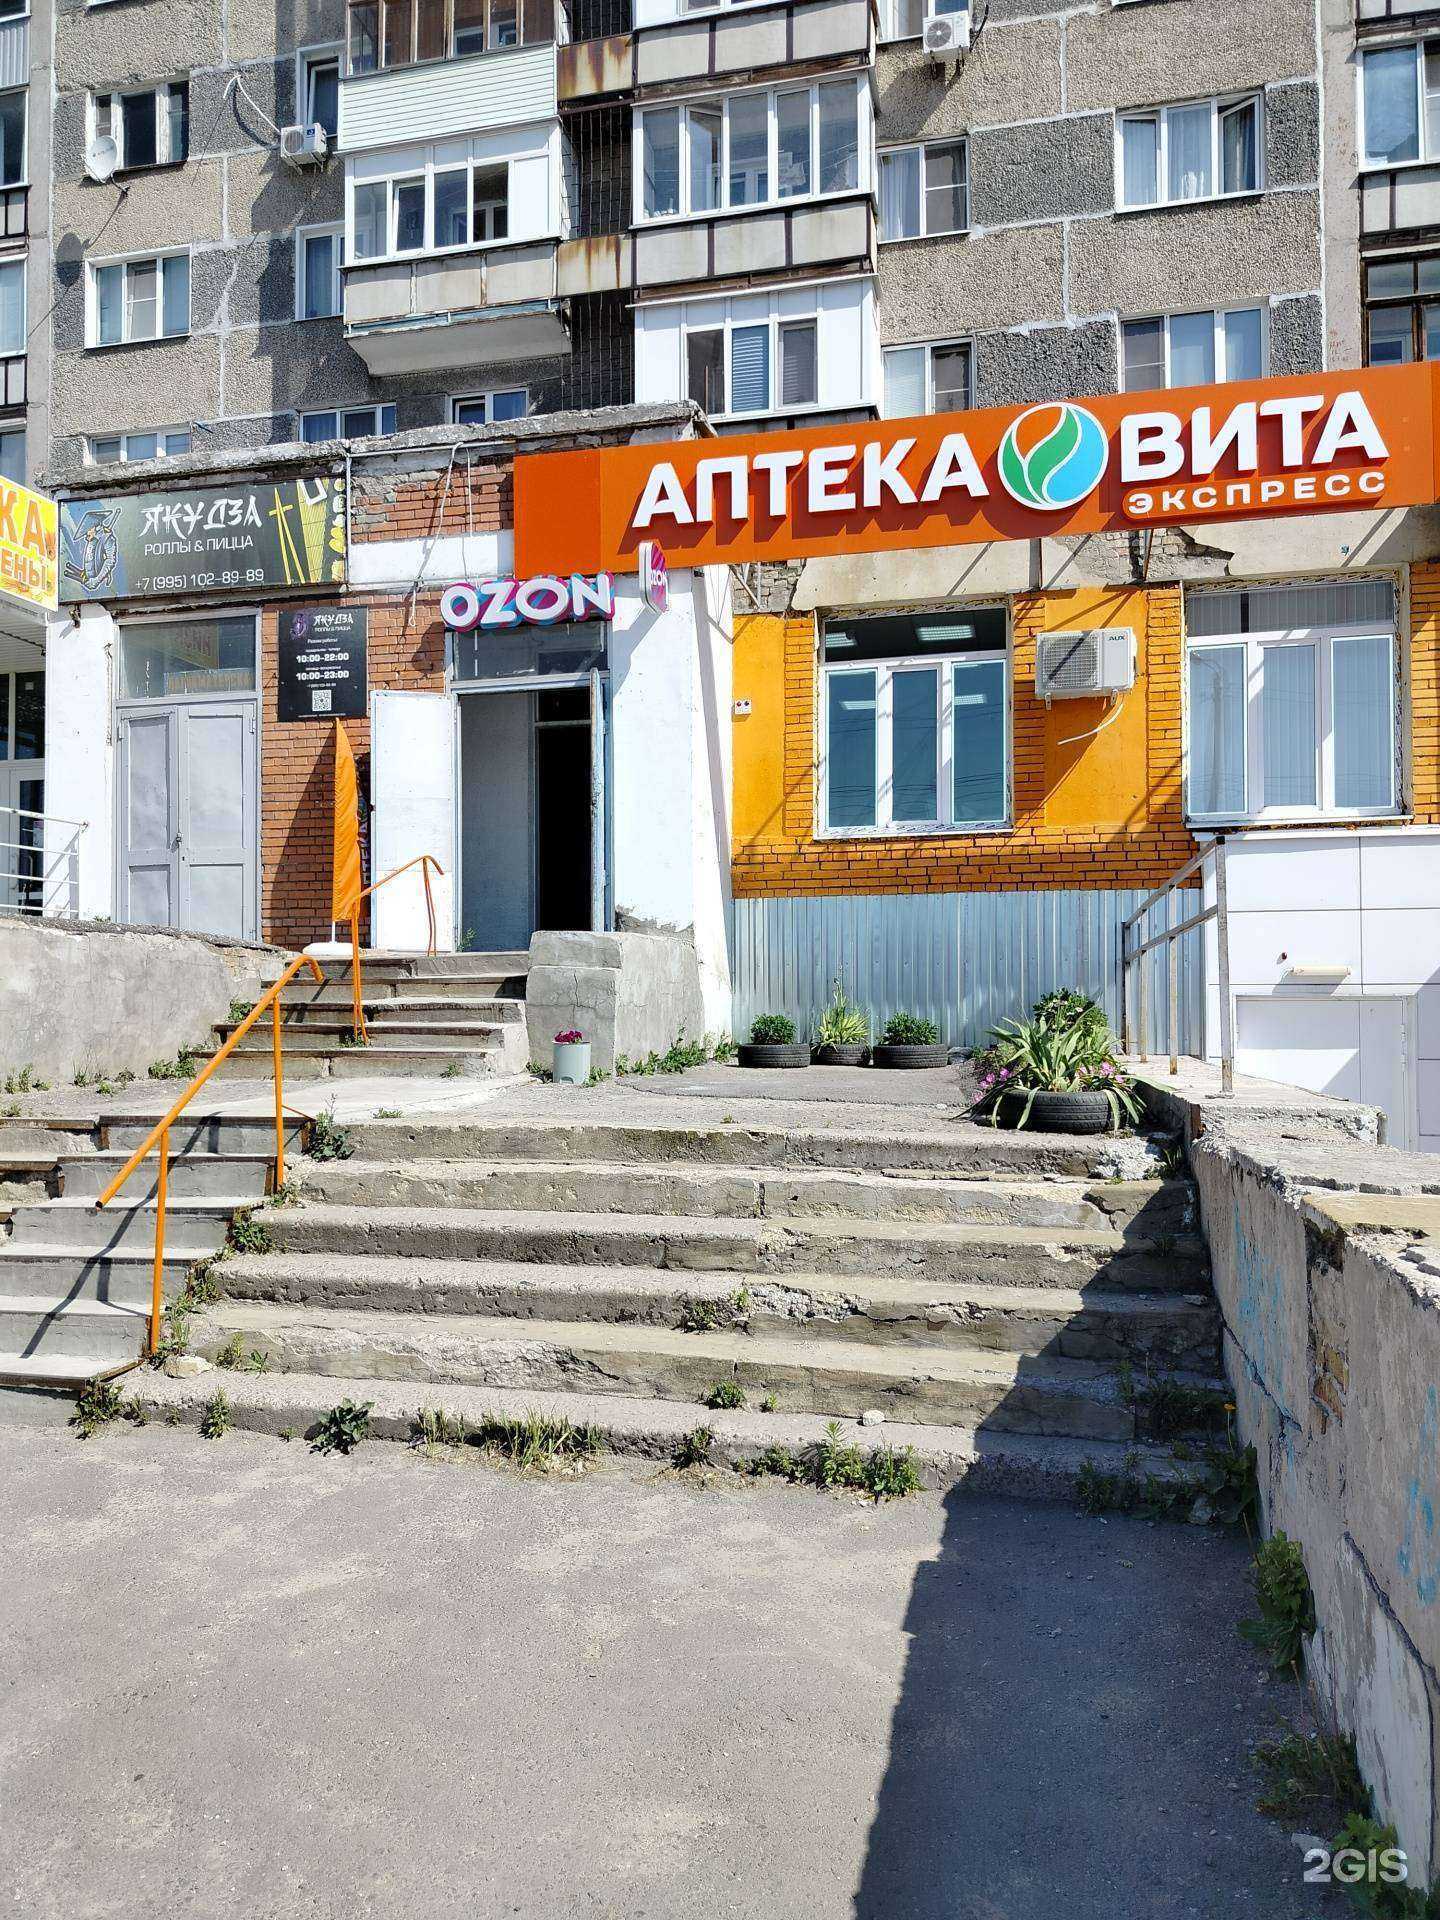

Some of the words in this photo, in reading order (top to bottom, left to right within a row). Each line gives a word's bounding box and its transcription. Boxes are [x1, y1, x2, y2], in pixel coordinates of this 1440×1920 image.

[632, 433, 990, 528] АПТЕКА
[1120, 390, 1390, 483] ВИТА
[1127, 471, 1386, 515] ЭКСПРЕСС
[138, 494, 263, 540] ЯКУДЗА
[144, 540, 191, 556] РОЛЛЫ
[194, 539, 205, 552] &
[206, 534, 254, 551] ПИЦЦА
[135, 577, 150, 591] +7
[153, 574, 187, 589] (995)
[190, 568, 265, 587] 102-89-89
[441, 571, 613, 629] OZON
[313, 613, 354, 628] ЯКУДЗА
[296, 652, 349, 663] 10:00-22:00
[296, 670, 349, 681] 10:00-23:00
